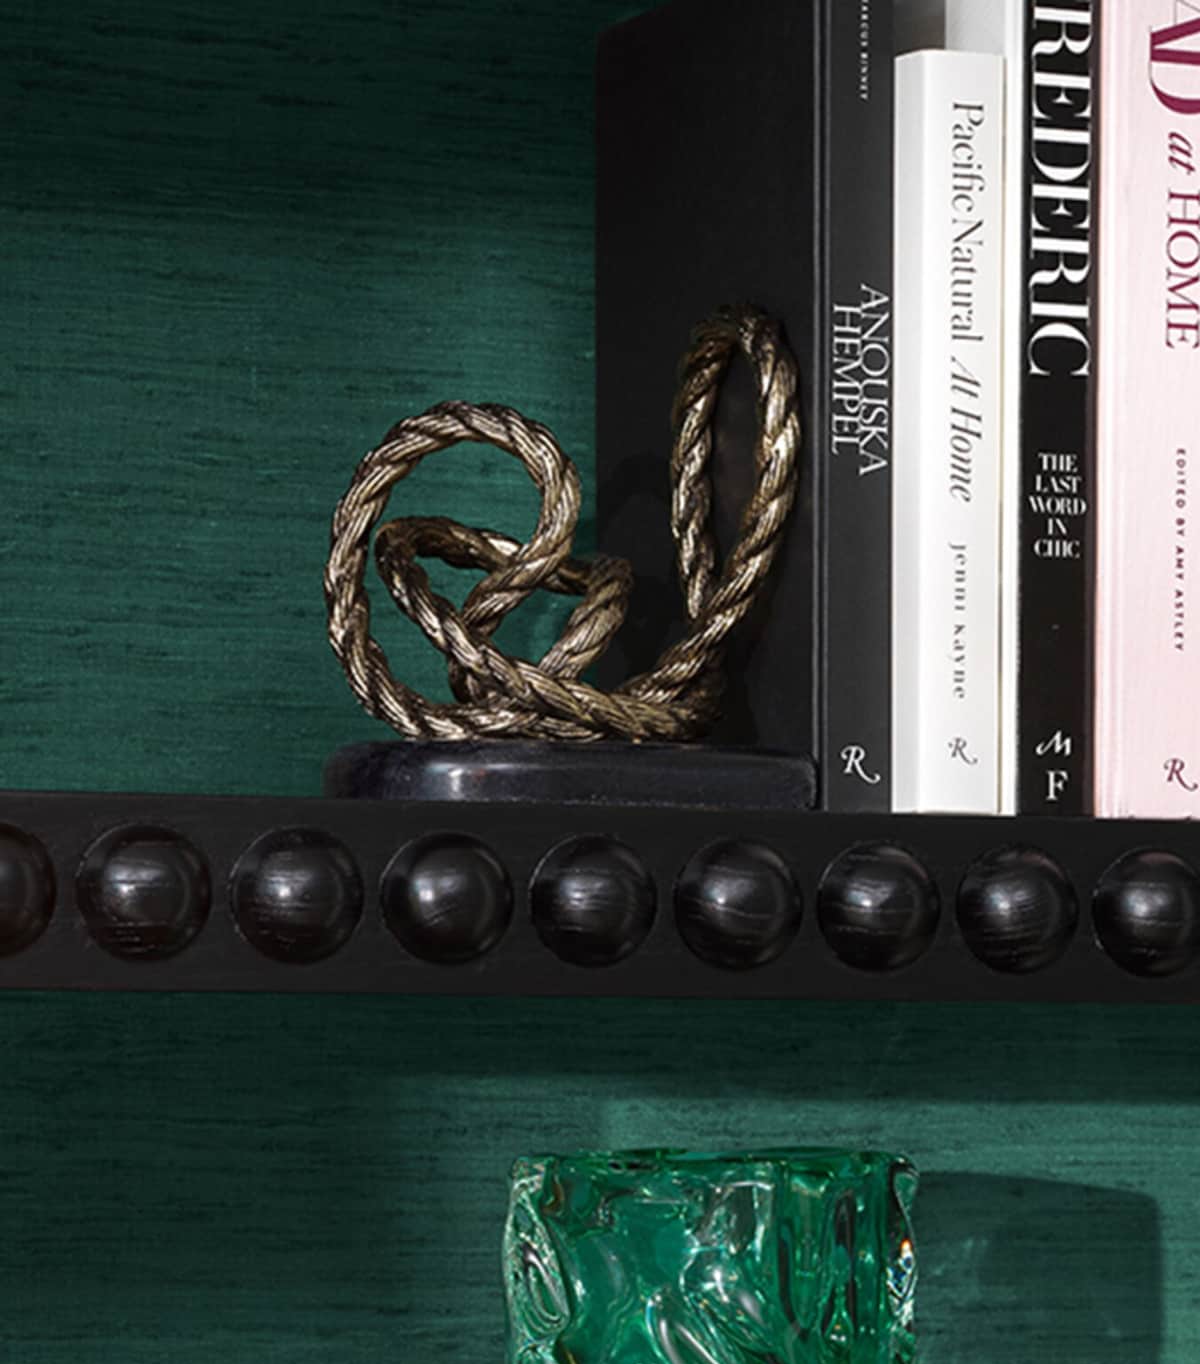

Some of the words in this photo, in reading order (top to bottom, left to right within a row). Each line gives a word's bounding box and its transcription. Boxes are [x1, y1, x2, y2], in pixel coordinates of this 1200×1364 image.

[952, 102, 986, 213] Pacific
[1167, 131, 1197, 174] at
[950, 217, 985, 342] Natural
[831, 303, 862, 455] HEMPEL
[858, 283, 891, 476] ANOUSKA
[950, 355, 982, 399] At
[949, 405, 983, 503] Home
[1038, 453, 1078, 474] THE
[1034, 475, 1082, 494] LAST
[1175, 448, 1187, 510] EDITED
[1028, 495, 1087, 516] WORD
[1047, 517, 1068, 536] IN
[1175, 517, 1186, 537] BY
[1033, 539, 1081, 559] CHIC
[1174, 546, 1186, 580] AMY
[1173, 588, 1186, 652] ASTLEY
[839, 745, 881, 785] R
[947, 736, 979, 765] R
[1045, 770, 1070, 801] F
[1164, 757, 1199, 792] R
